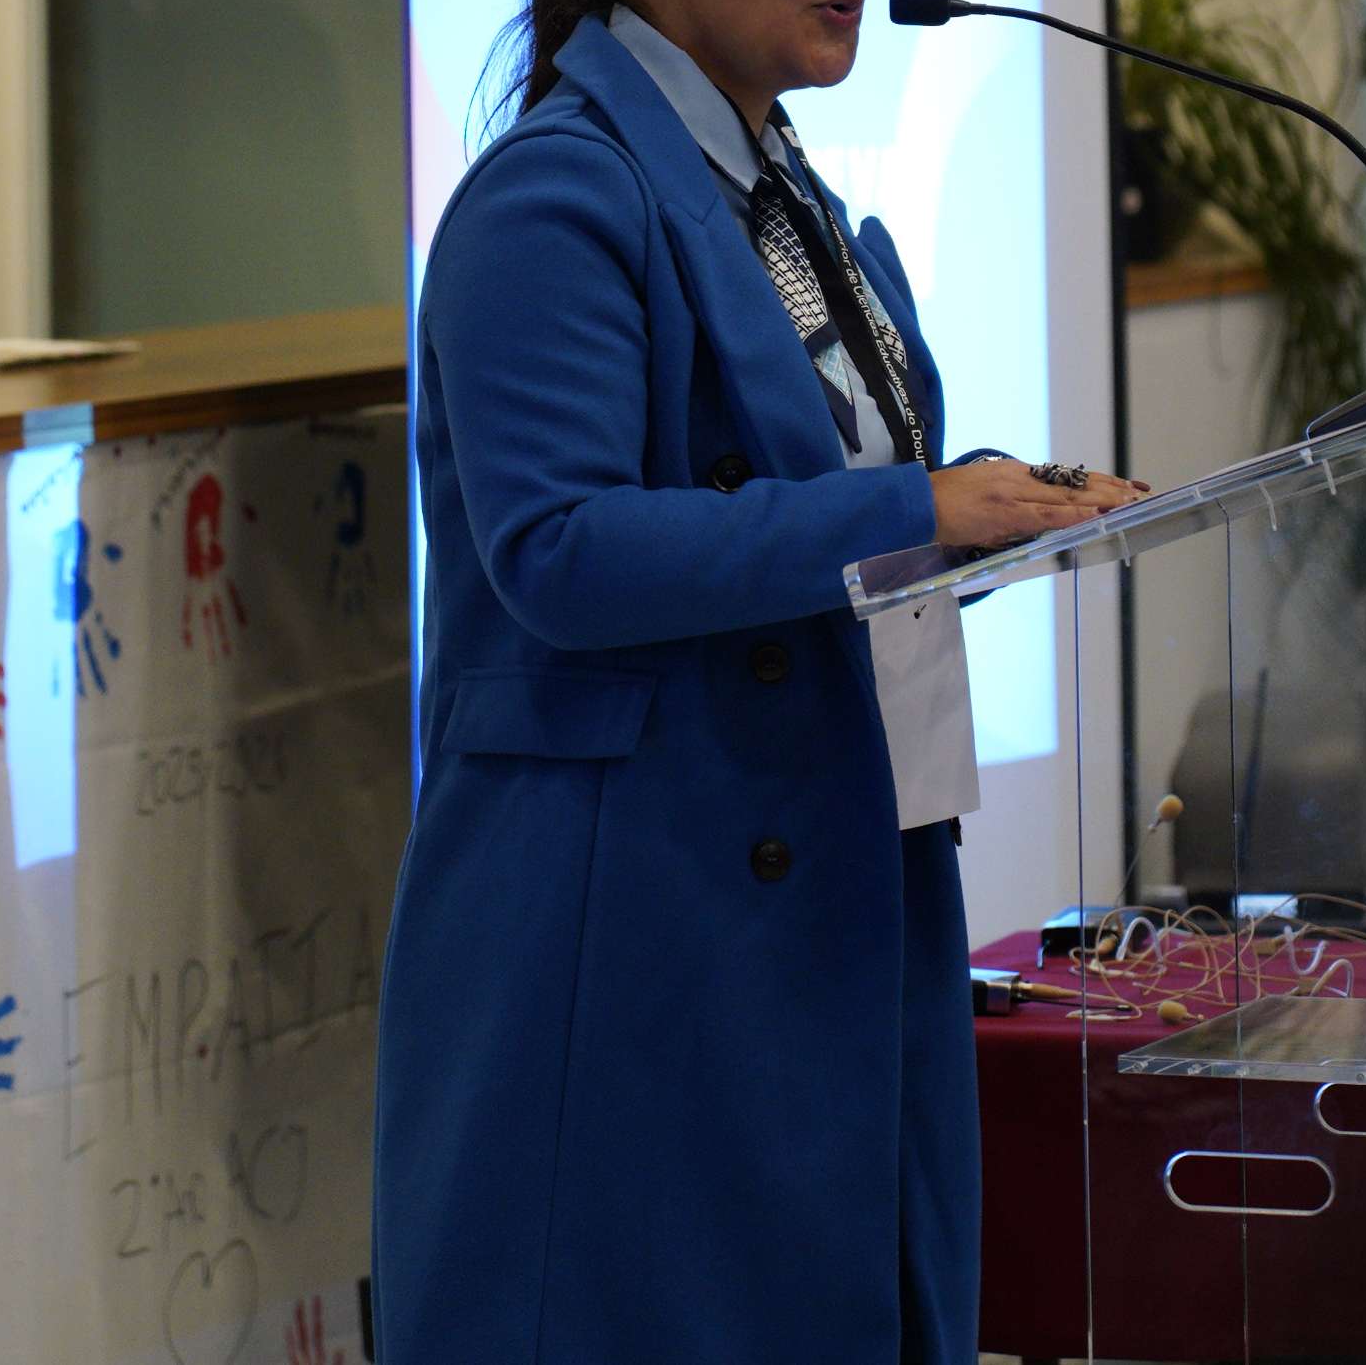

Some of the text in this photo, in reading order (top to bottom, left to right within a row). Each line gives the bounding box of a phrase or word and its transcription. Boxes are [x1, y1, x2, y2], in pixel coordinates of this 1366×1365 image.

[845, 267, 859, 284] de
[876, 339, 910, 405] Educativas
[905, 407, 916, 425] do
[911, 429, 926, 467] Dour
